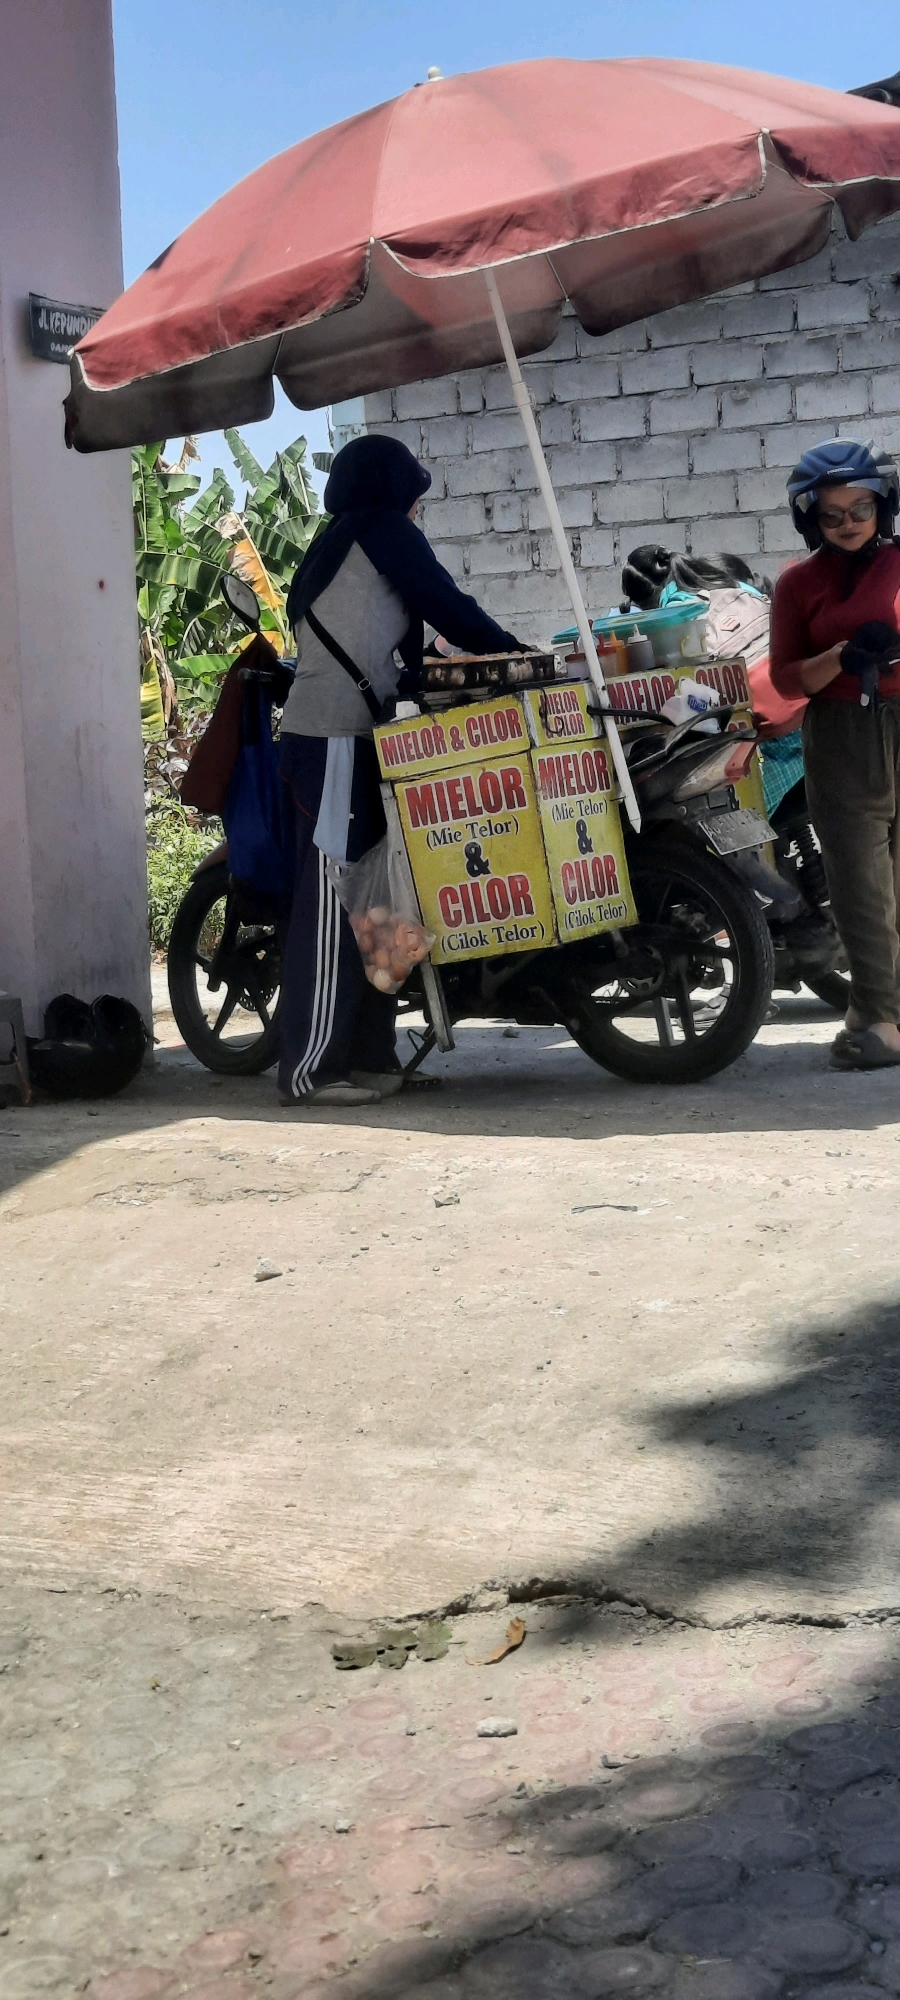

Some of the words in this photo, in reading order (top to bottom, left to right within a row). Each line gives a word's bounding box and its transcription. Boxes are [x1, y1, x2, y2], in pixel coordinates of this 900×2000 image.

[540, 690, 580, 716] MIELOR
[380, 725, 448, 768] MIELOR
[449, 726, 465, 752] &
[466, 708, 523, 748] CILOR
[554, 713, 586, 737] CILOR
[538, 750, 611, 800] MIELOR
[405, 768, 527, 828] MIELOR
[552, 802, 575, 825] (Mie
[576, 796, 608, 817] Telor)
[426, 827, 462, 851] (Mie
[465, 815, 519, 839] Telor)
[576, 819, 594, 855] &
[465, 842, 491, 877] &
[561, 854, 620, 906] CILOR
[438, 874, 535, 928] CILOR
[564, 907, 596, 930] (Cilok
[596, 900, 628, 921] Telor)
[441, 930, 490, 955] (Cilok
[492, 920, 545, 943] Telor)
